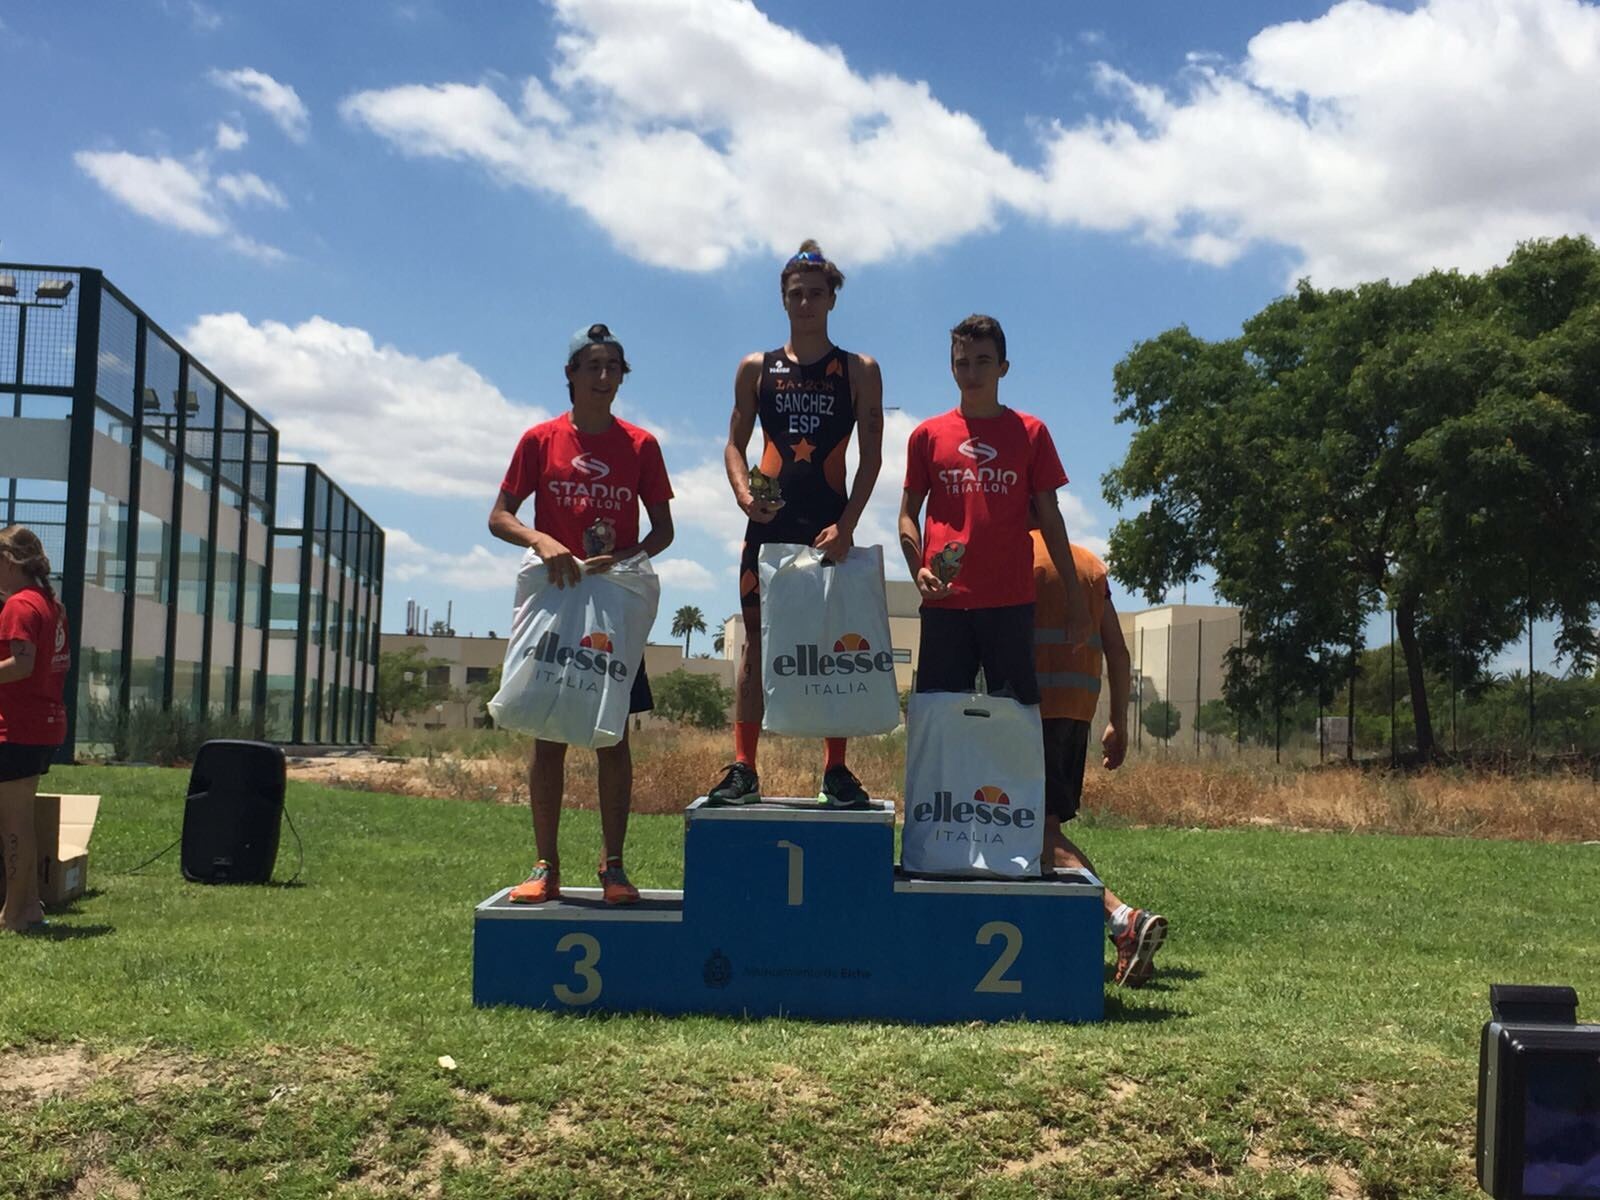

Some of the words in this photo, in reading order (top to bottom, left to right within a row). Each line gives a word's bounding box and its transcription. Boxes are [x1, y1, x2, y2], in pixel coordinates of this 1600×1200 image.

[775, 393, 835, 415] SANCHEZ
[788, 415, 821, 434] ESP
[938, 467, 1018, 486] STADIO
[548, 480, 633, 502] STADIO
[945, 482, 1009, 495] TRIATLON
[555, 496, 622, 511] TRIATLON
[773, 644, 894, 676] ellesse
[535, 670, 598, 693] ITALIA
[804, 682, 869, 696] ITALIA
[913, 791, 1035, 828] ellesse
[935, 829, 1005, 845] ITALIA
[776, 840, 804, 906] 1
[974, 921, 1023, 994] 2
[552, 932, 603, 1006] 3
